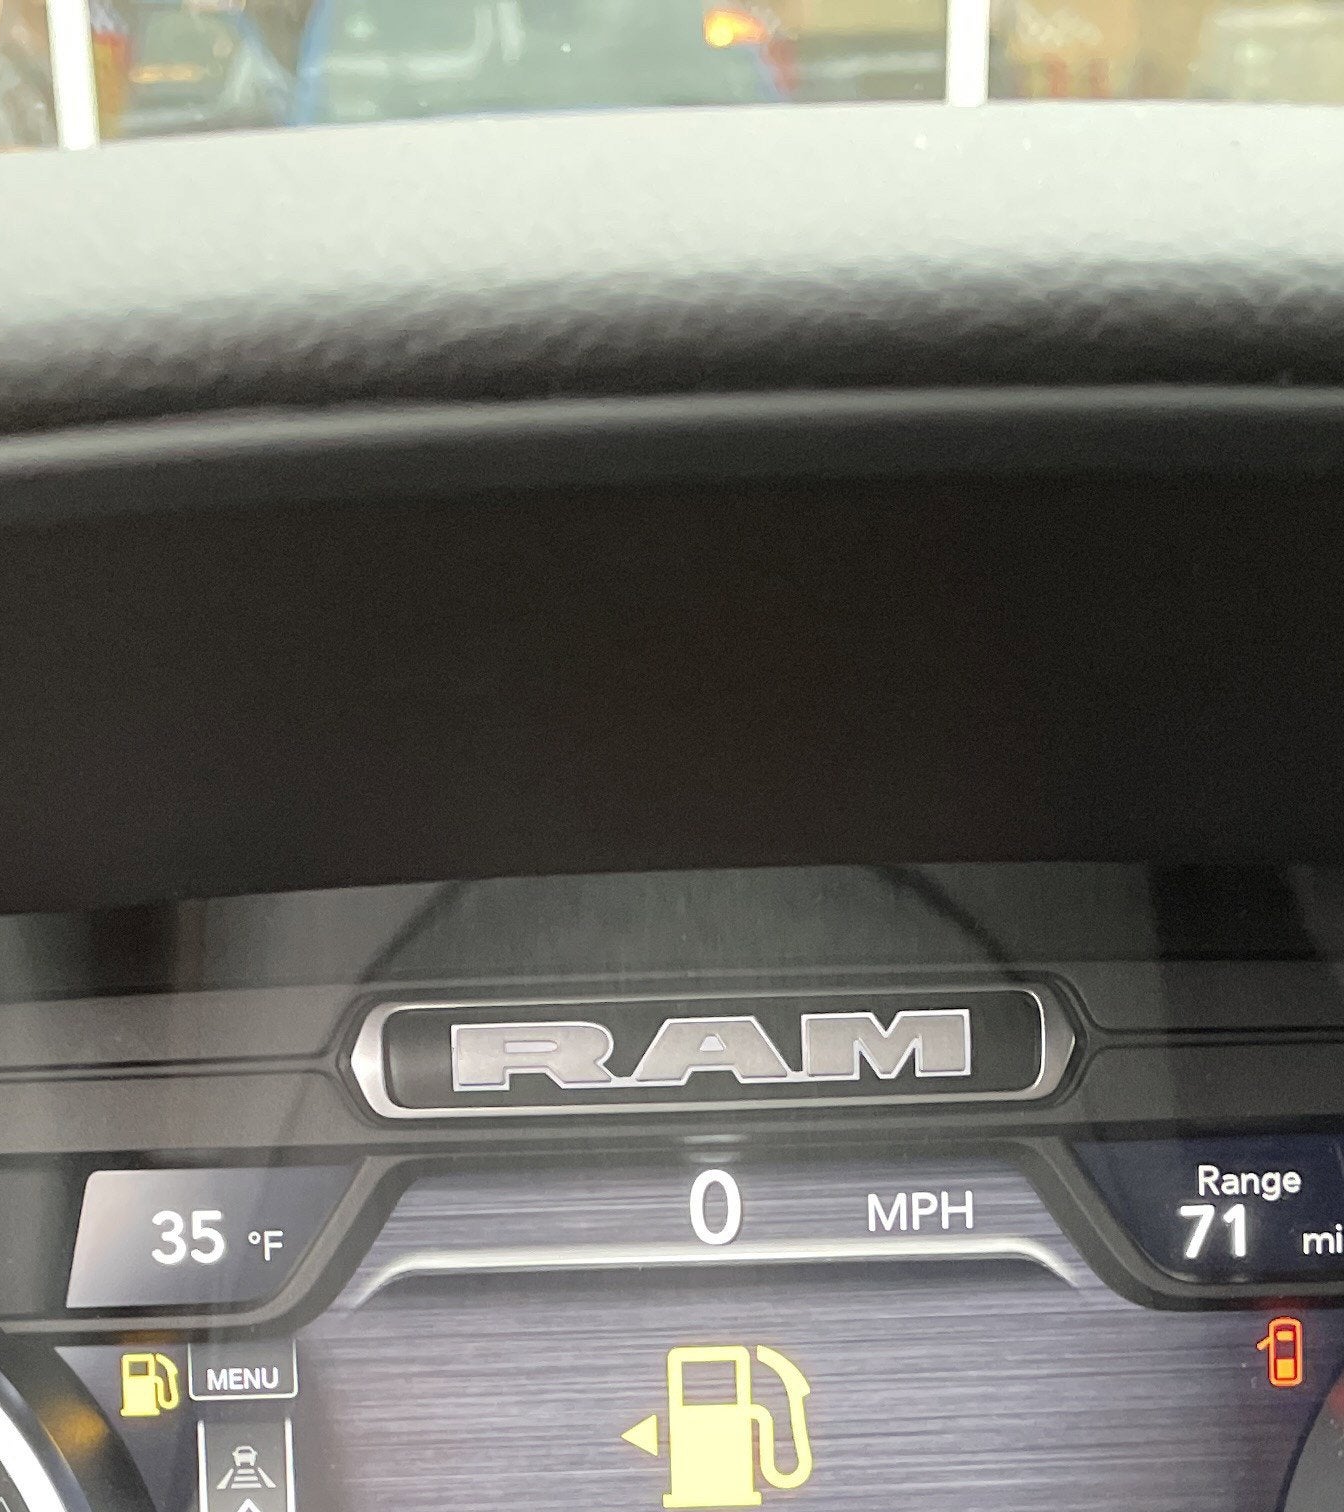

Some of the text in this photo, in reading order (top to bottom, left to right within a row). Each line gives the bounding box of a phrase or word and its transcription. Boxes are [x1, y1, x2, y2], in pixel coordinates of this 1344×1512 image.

[451, 1012, 971, 1091] RAM
[690, 1171, 974, 1245] 0 MPH
[1197, 1165, 1301, 1201] Range
[152, 1210, 225, 1265] 35
[1179, 1204, 1343, 1259] 71 mi
[207, 1367, 278, 1390] MENU
